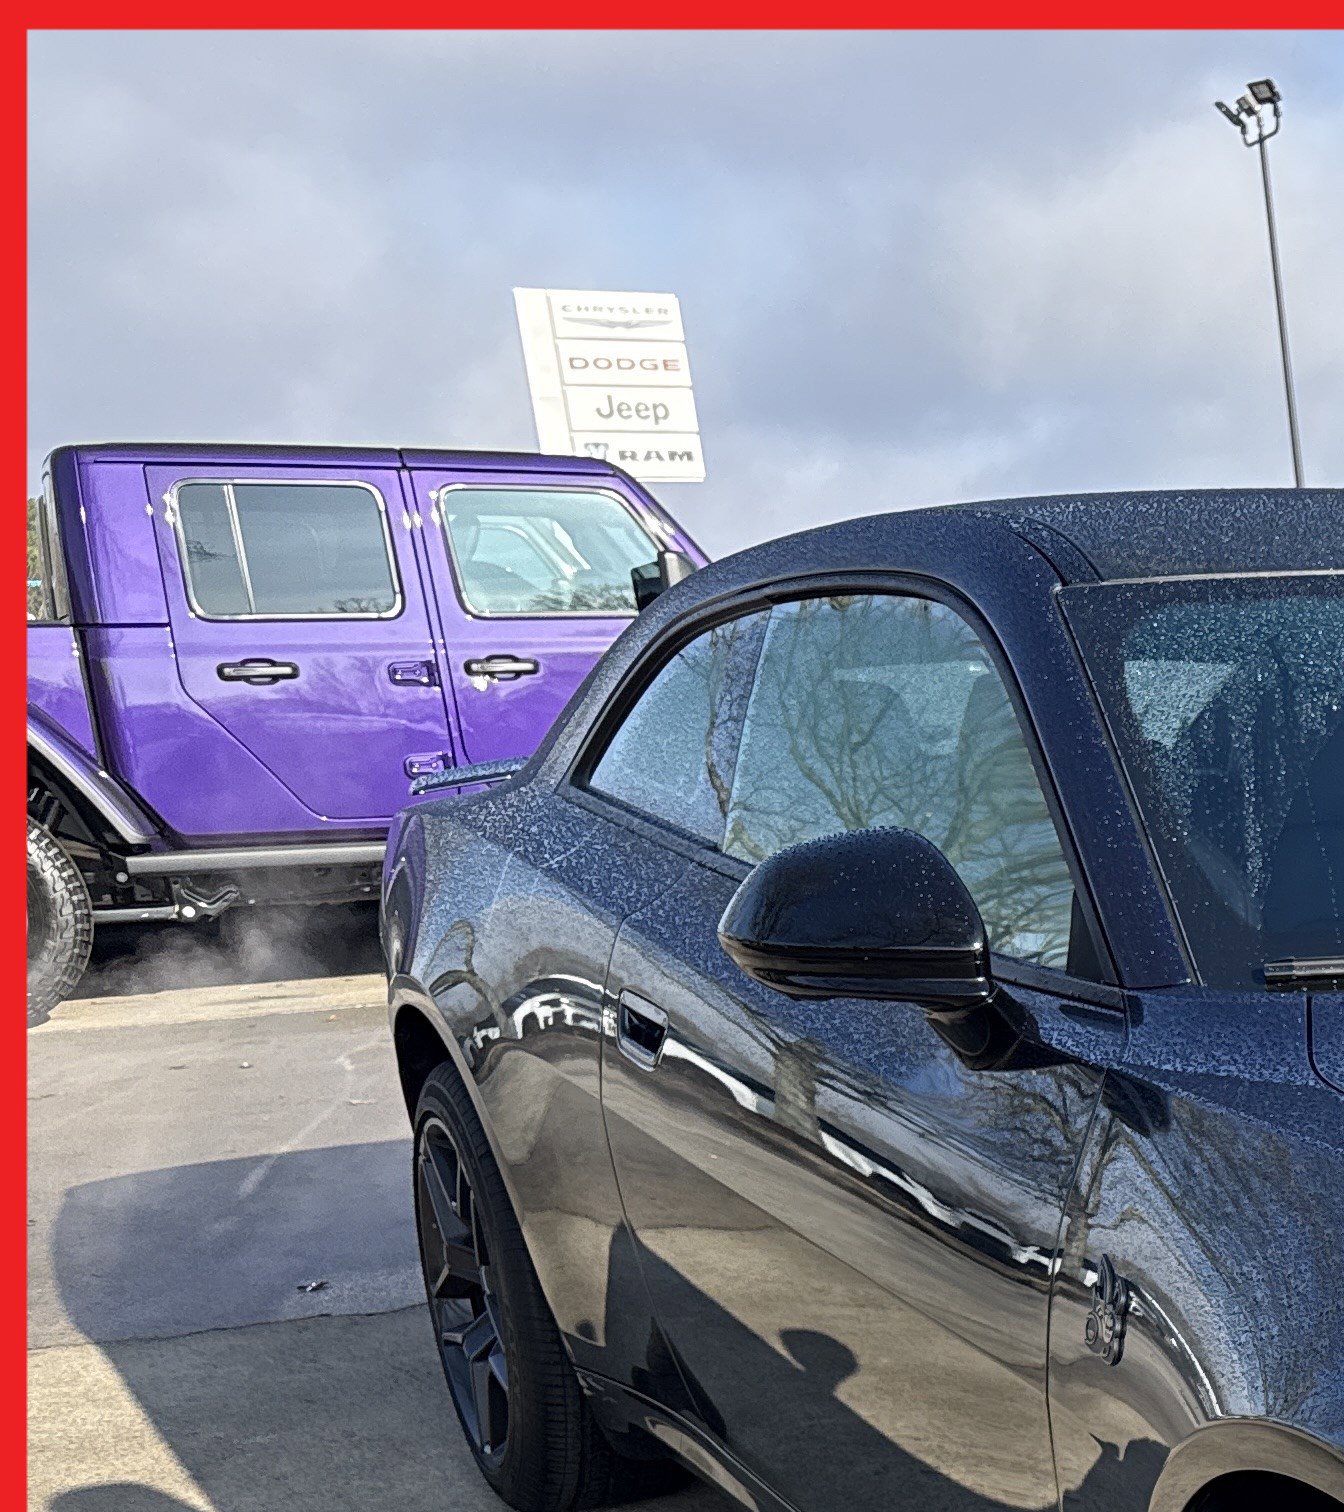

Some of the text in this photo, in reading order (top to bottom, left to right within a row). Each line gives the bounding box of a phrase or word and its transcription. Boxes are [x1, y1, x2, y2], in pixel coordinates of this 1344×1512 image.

[561, 304, 670, 316] CHRYSLER
[569, 356, 681, 372] DODGE
[595, 394, 670, 425] Jeep
[618, 450, 695, 462] RAM
